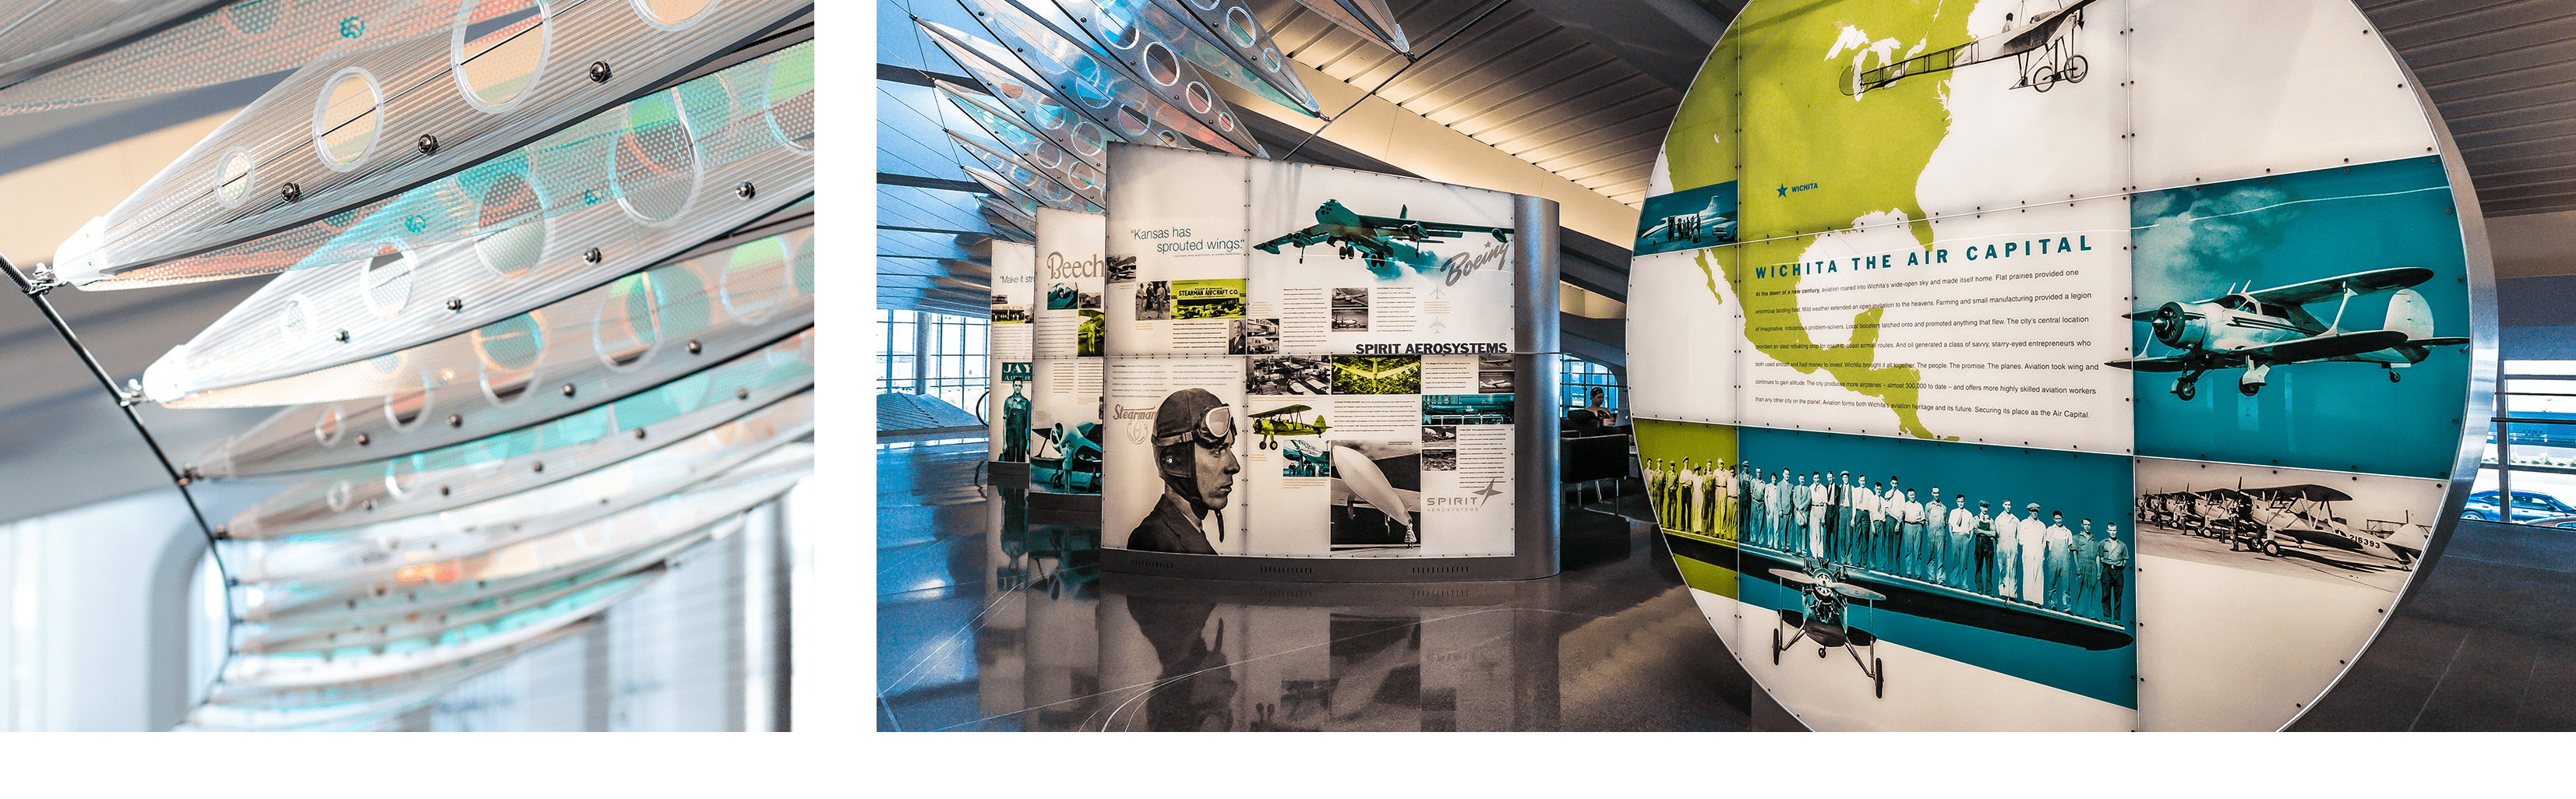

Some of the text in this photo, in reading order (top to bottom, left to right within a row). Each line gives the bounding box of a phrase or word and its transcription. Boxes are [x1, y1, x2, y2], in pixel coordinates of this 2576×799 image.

[1791, 182, 1819, 192] WICHITA
[1130, 227, 1191, 240] “Kansas has
[1156, 239, 1203, 254] sprouted
[1756, 234, 2092, 279] WICHITA THE AIR CAPITAL
[1046, 251, 1105, 280] Beech
[1440, 241, 1509, 287] Boeing
[1801, 286, 1821, 295] century,
[1890, 280, 1918, 289] wide-open
[1918, 279, 1928, 287] sky
[2008, 271, 2033, 281] prairies
[2034, 269, 2063, 280] provided
[1936, 297, 1959, 307] Farming
[1989, 294, 2033, 304] manufacturing
[2034, 292, 2063, 302] provided
[2070, 290, 2091, 301] legion
[1925, 319, 1952, 328] promoted
[1953, 319, 1978, 327] anything
[2062, 315, 2089, 323] location
[1355, 343, 1508, 354] SPIRIT AEROSYSTEMS
[1992, 340, 2027, 348] starry-eyed
[2027, 339, 2074, 348] entrepreneurs
[1003, 364, 1032, 373] JAY
[1893, 361, 1916, 370] together.
[1928, 361, 1949, 370] people.
[1961, 362, 1986, 371] promise.
[2000, 362, 2023, 371] planes.
[2067, 362, 2084, 371] wing
[1859, 381, 1882, 389] airplanes
[1905, 382, 1927, 390] 300,000
[1999, 385, 2018, 393] highly
[2069, 386, 2096, 395] workers
[1911, 403, 1934, 412] heritage
[1974, 406, 2001, 415] Securing
[2011, 407, 2029, 417] place
[2063, 410, 2090, 420] Capital.
[1427, 497, 1478, 505] SPIRIT
[2349, 534, 2380, 549] 216393
